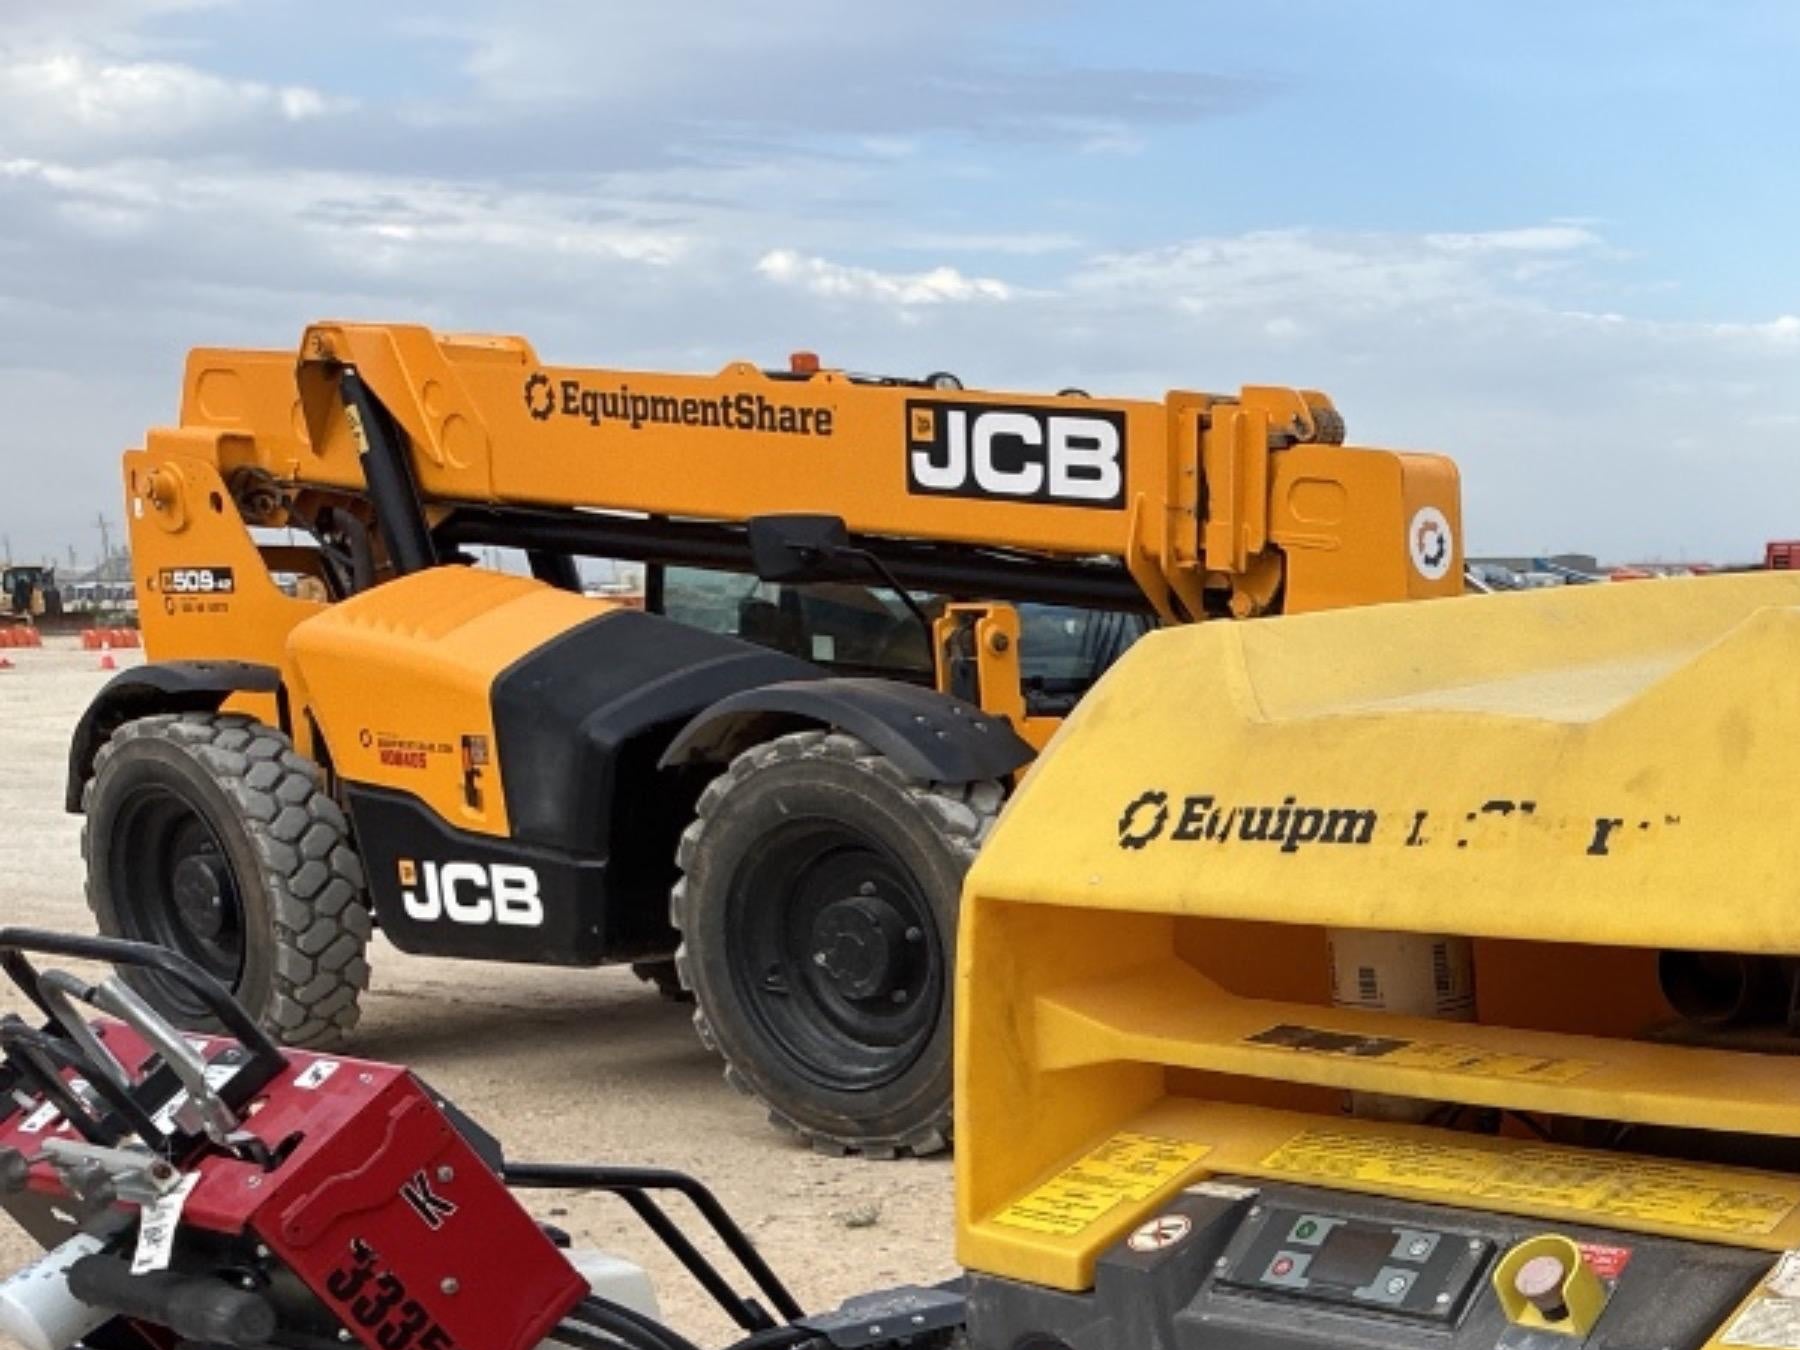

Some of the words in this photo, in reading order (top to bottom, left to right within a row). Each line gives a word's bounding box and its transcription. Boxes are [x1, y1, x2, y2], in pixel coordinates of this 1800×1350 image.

[560, 380, 833, 436] EquipmentShare
[911, 409, 1122, 501] JCB
[402, 860, 545, 927] JCB
